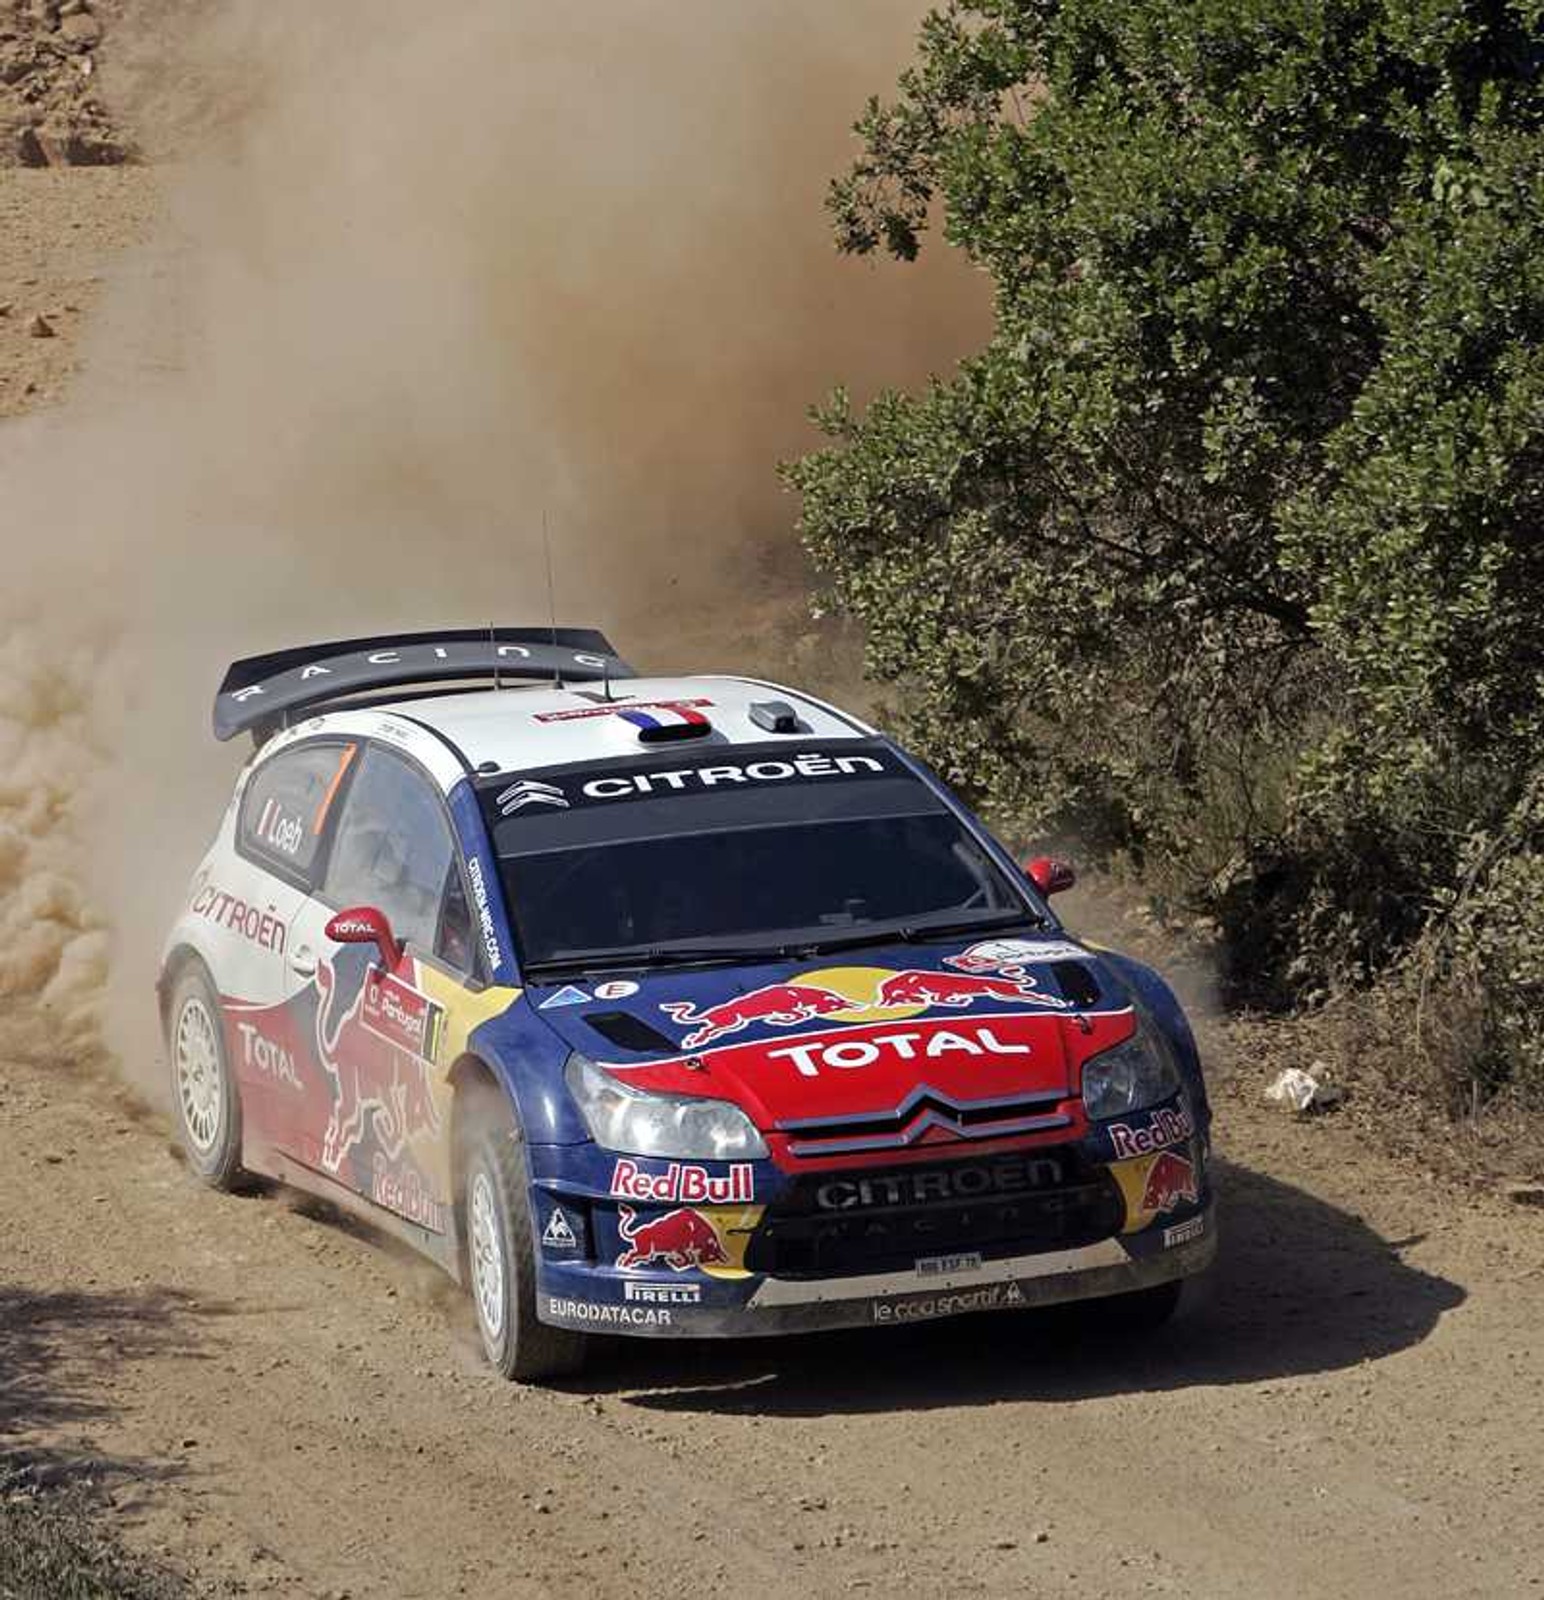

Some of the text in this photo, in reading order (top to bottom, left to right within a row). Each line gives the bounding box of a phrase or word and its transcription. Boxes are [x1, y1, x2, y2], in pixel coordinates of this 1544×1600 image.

[333, 920, 377, 933] TOTAL
[768, 1028, 1031, 1076] TOTAL
[624, 1281, 701, 1303] PIRELLI
[549, 1298, 672, 1325] EURODATACAR
